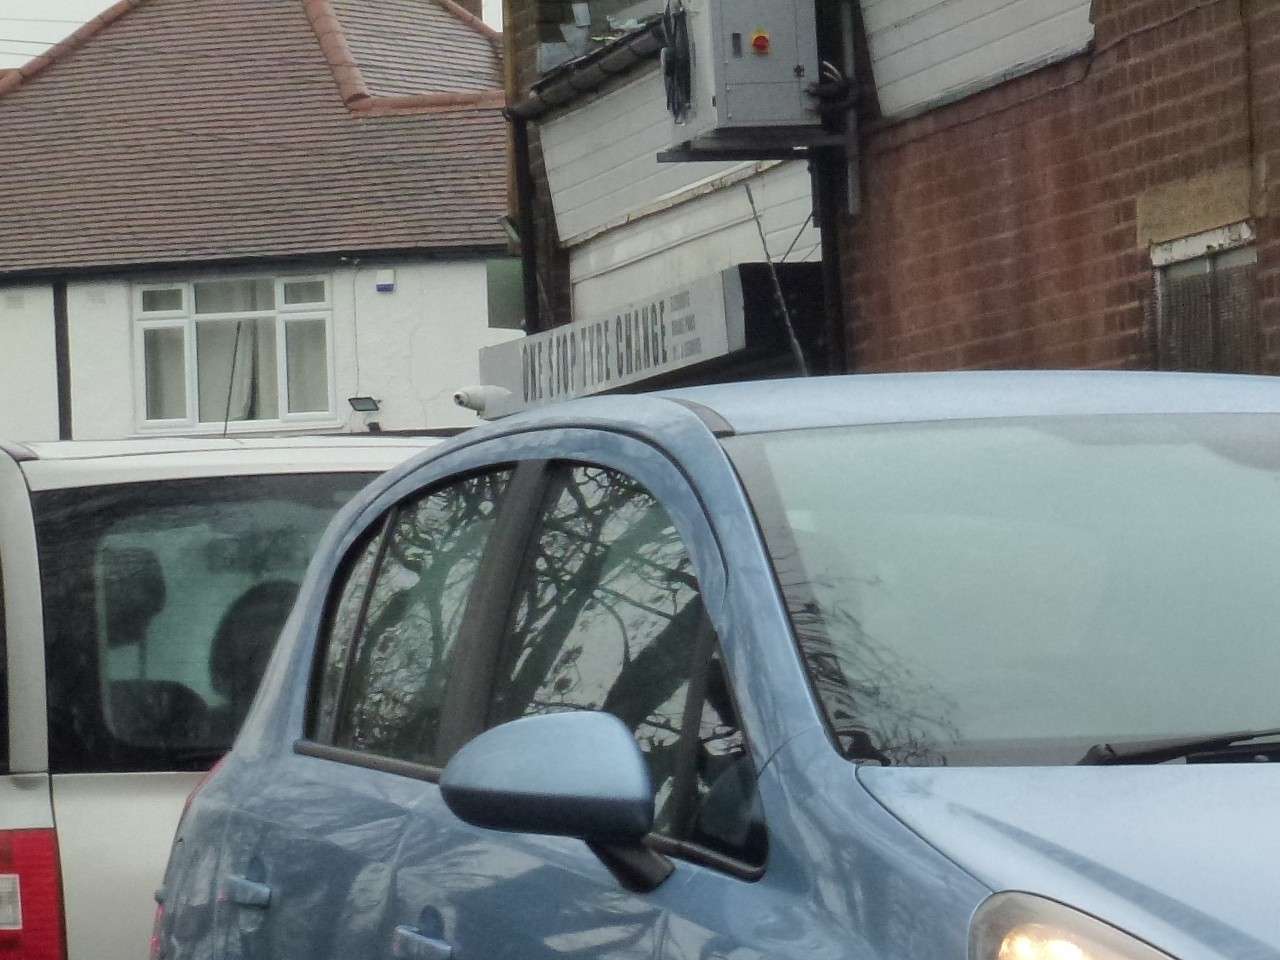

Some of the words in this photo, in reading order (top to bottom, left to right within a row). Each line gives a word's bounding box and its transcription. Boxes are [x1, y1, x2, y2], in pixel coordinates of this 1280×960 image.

[522, 344, 544, 403] ONE
[548, 332, 577, 398] STOP
[581, 320, 611, 387] TYRE
[616, 300, 668, 378] CHANGE
